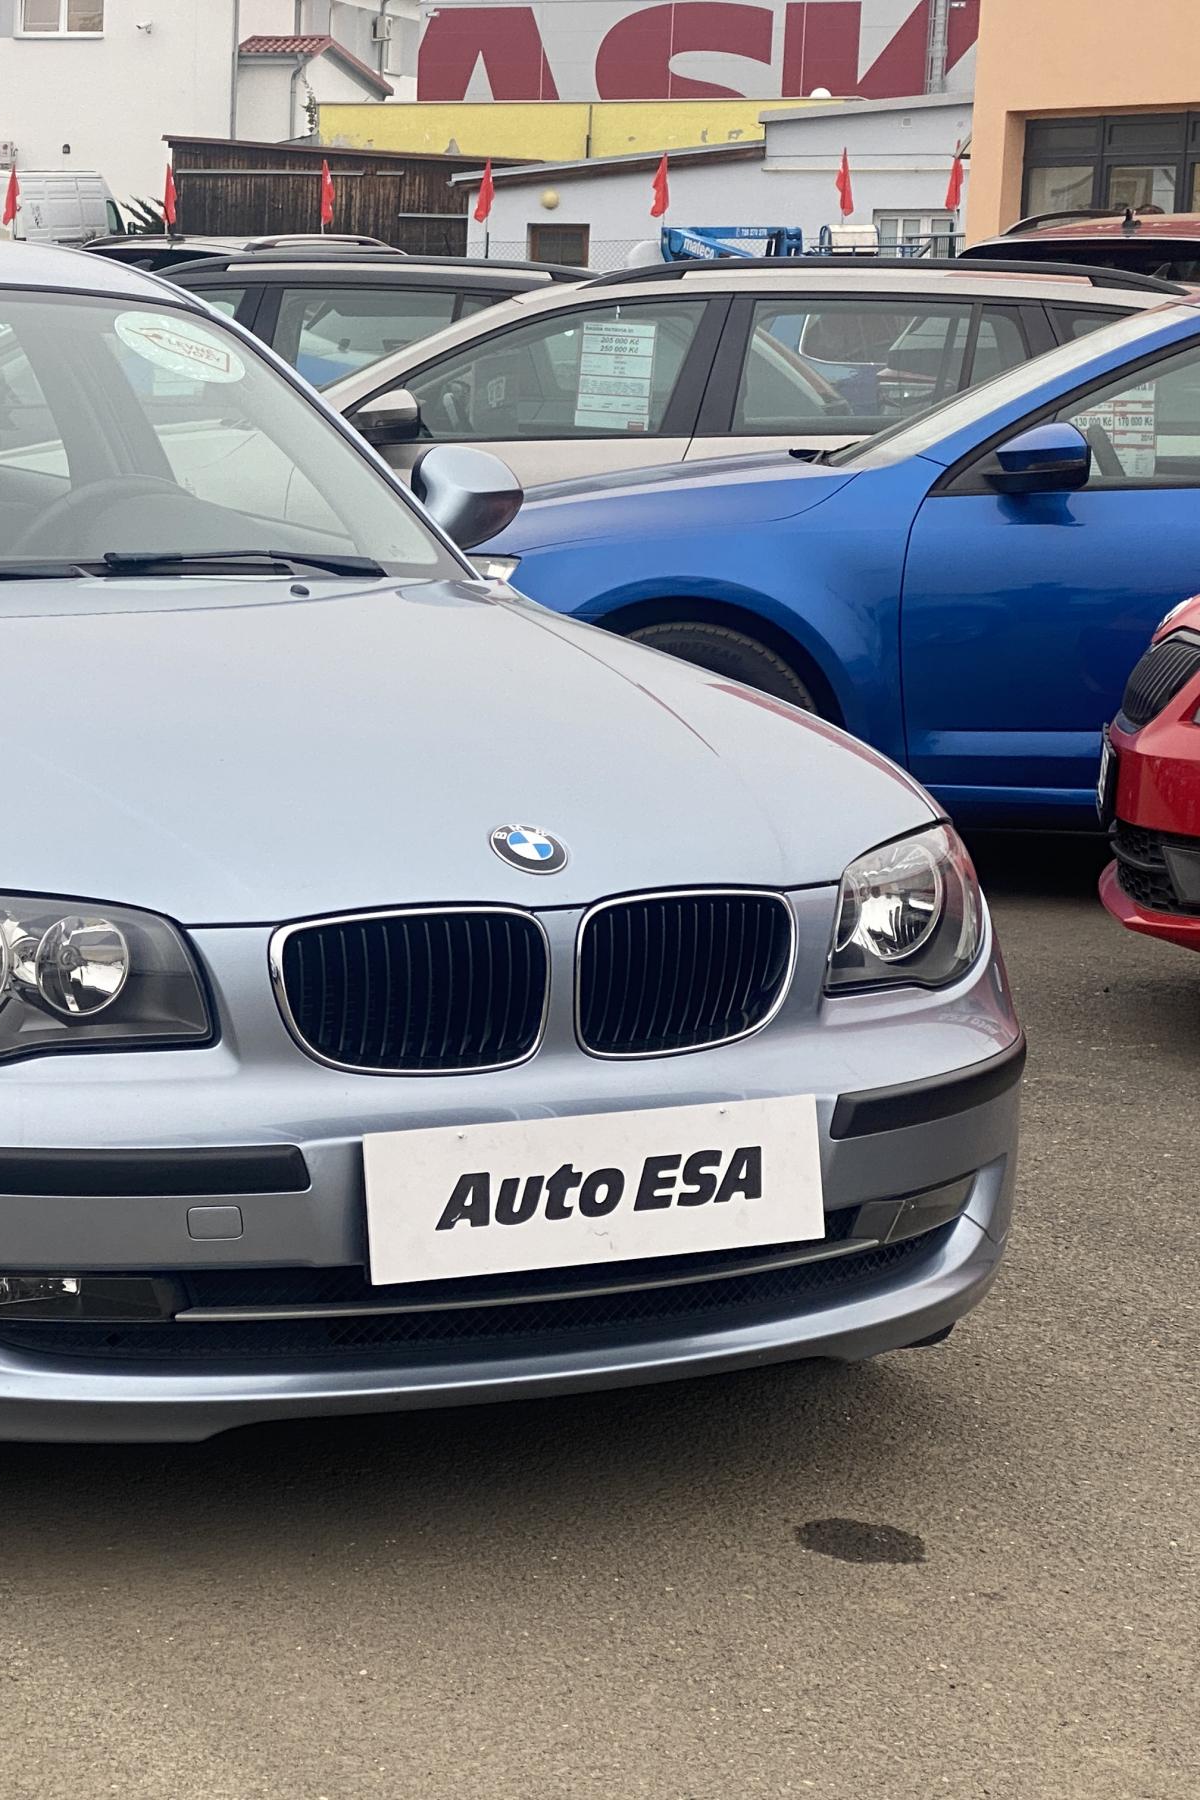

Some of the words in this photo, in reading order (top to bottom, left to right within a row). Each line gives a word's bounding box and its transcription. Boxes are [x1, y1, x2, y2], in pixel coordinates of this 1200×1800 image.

[683, 238, 714, 259] mateco
[1074, 417, 1087, 427] 130
[435, 1163, 625, 1231] Auto
[633, 1146, 762, 1212] ESA
